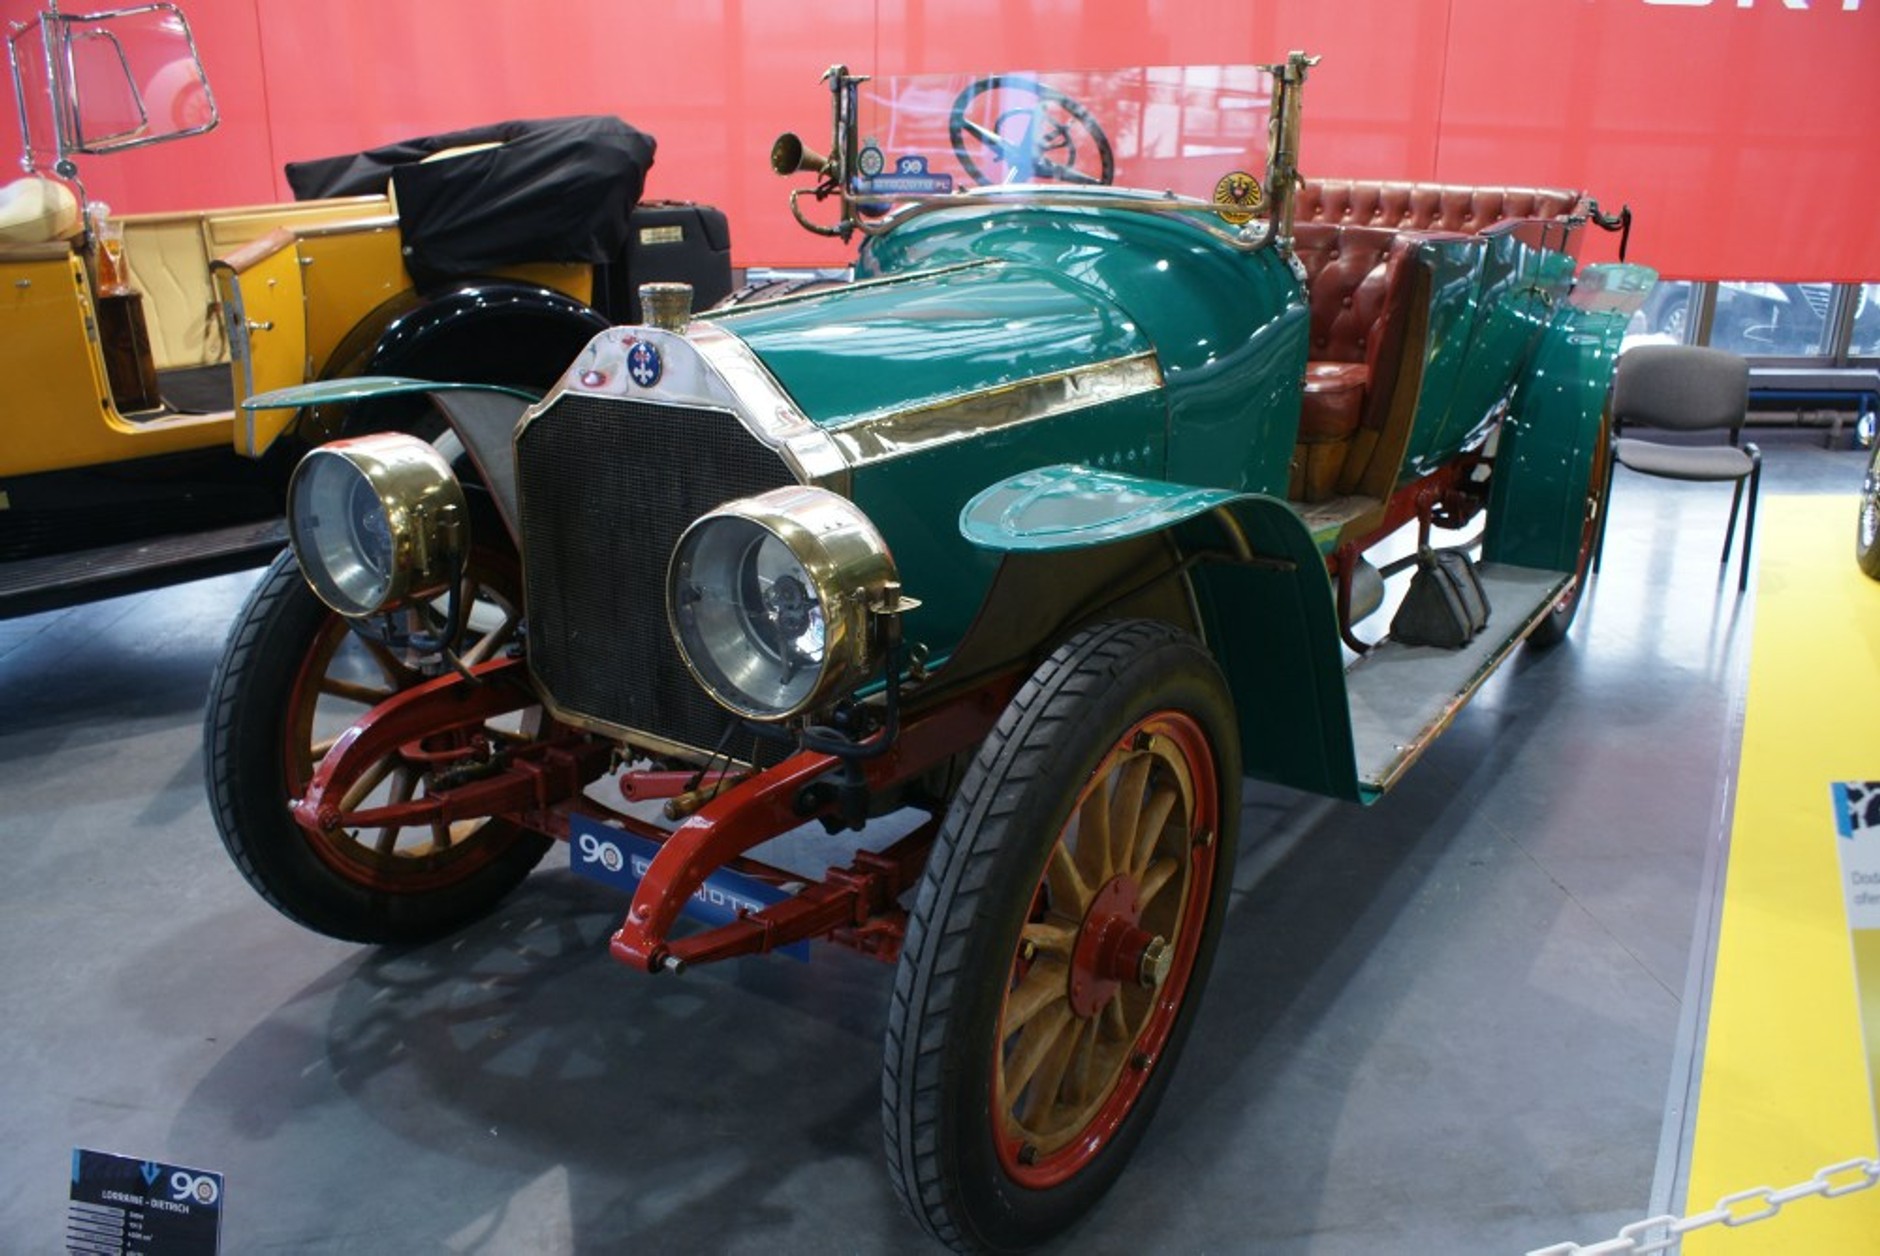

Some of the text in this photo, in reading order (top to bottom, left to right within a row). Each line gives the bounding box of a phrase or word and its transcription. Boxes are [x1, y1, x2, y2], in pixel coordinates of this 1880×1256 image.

[579, 833, 623, 872] 90
[102, 1190, 144, 1206] LORRAINE
[150, 1198, 189, 1214] DIETRICH
[171, 1171, 218, 1204] 90
